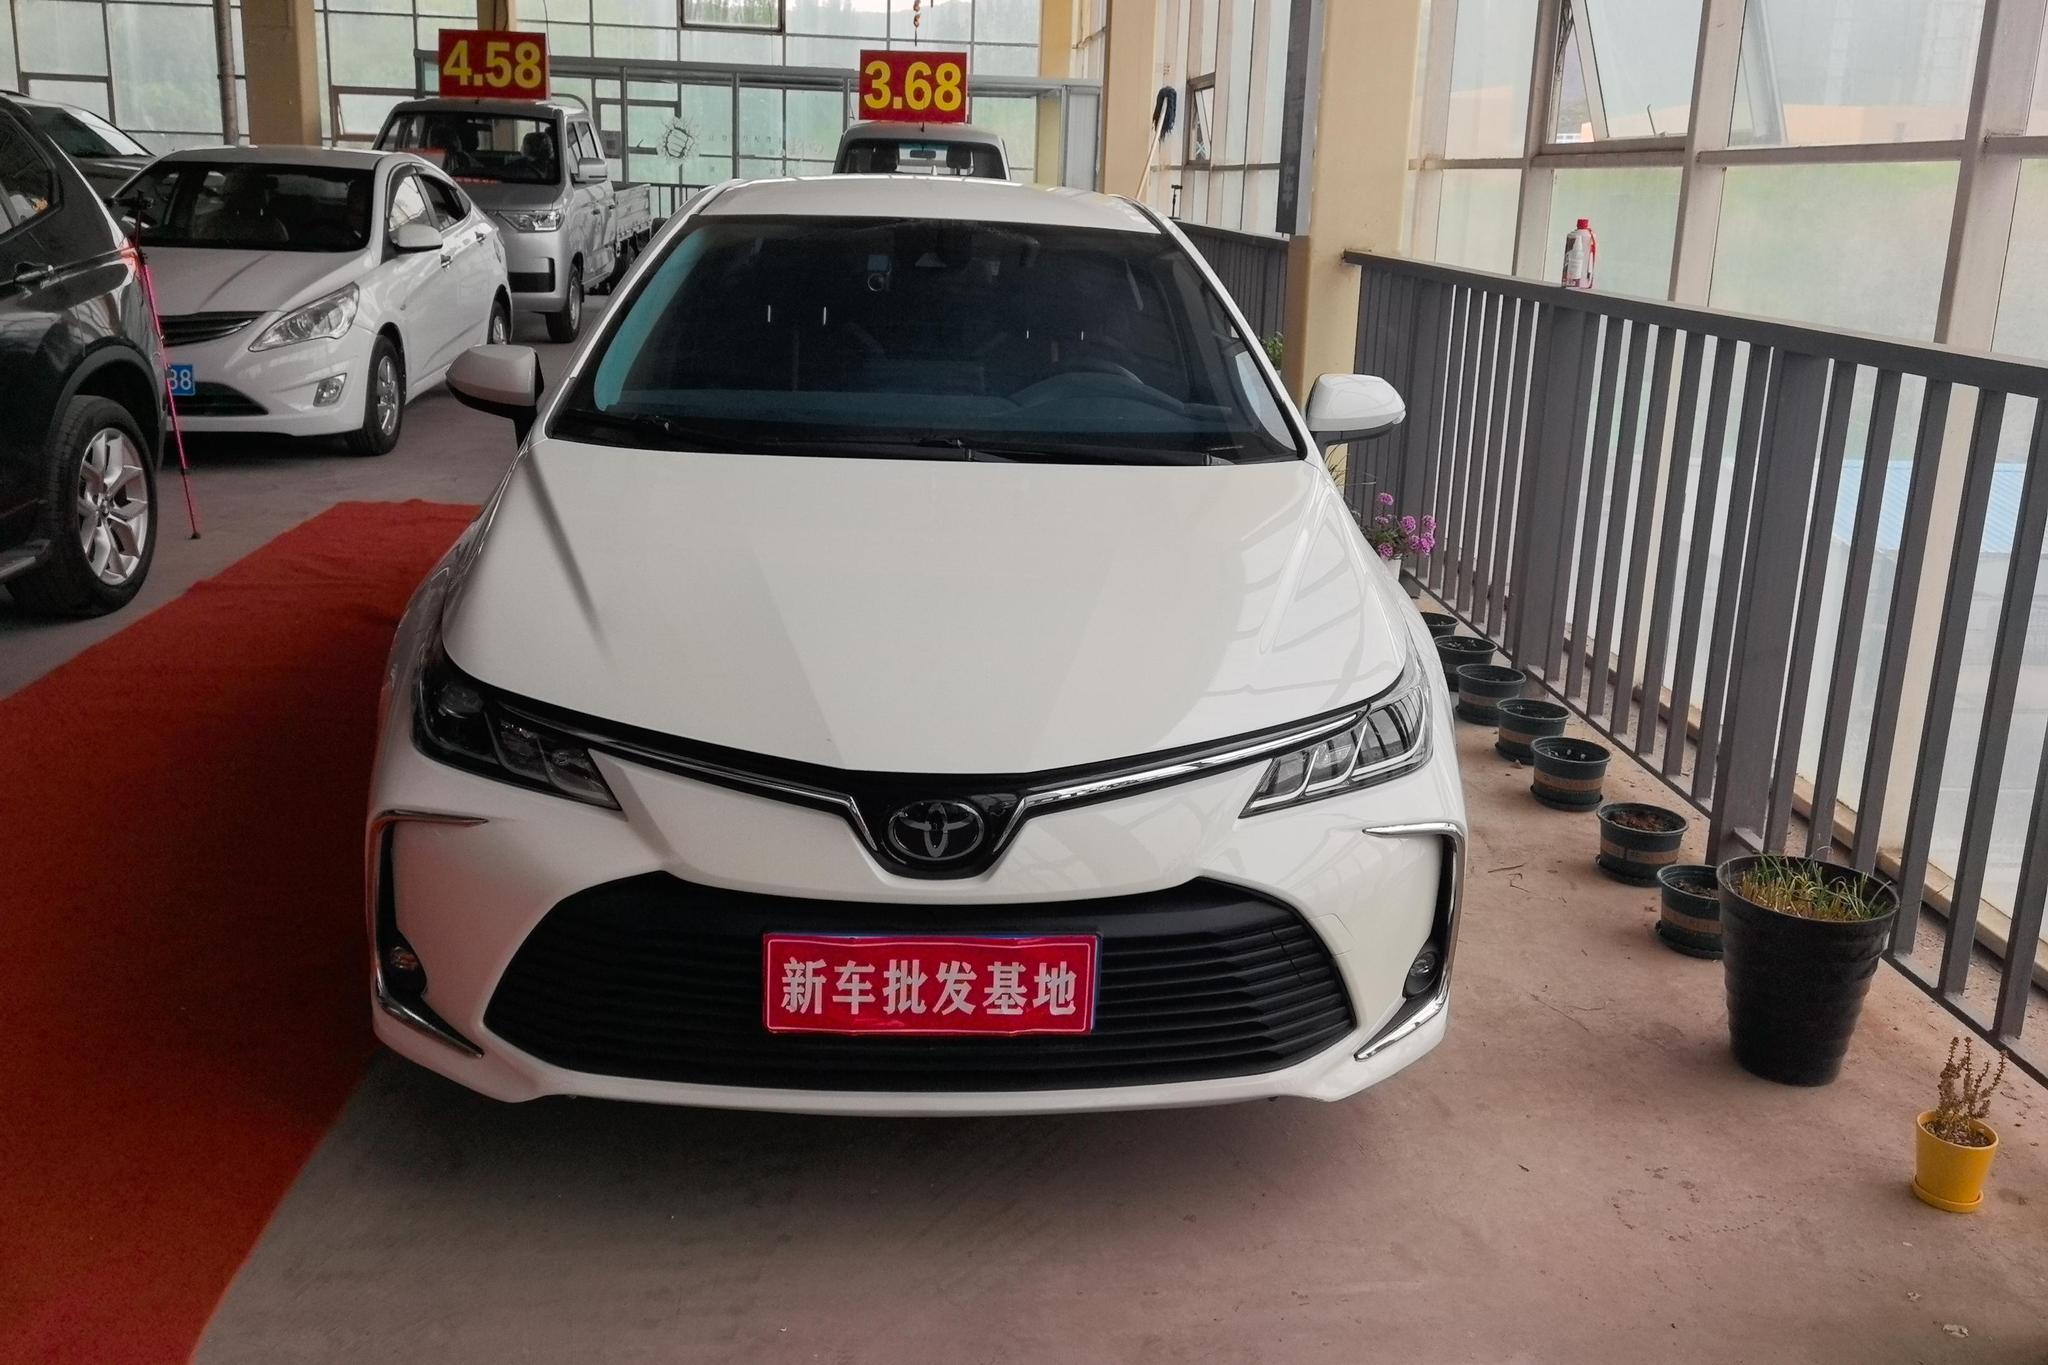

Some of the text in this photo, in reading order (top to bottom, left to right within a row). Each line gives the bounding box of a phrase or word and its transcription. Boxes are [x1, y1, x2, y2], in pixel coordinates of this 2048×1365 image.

[443, 40, 541, 89] 4.58
[864, 61, 962, 112] 3.68
[781, 956, 1077, 1016] 新车批发基地
